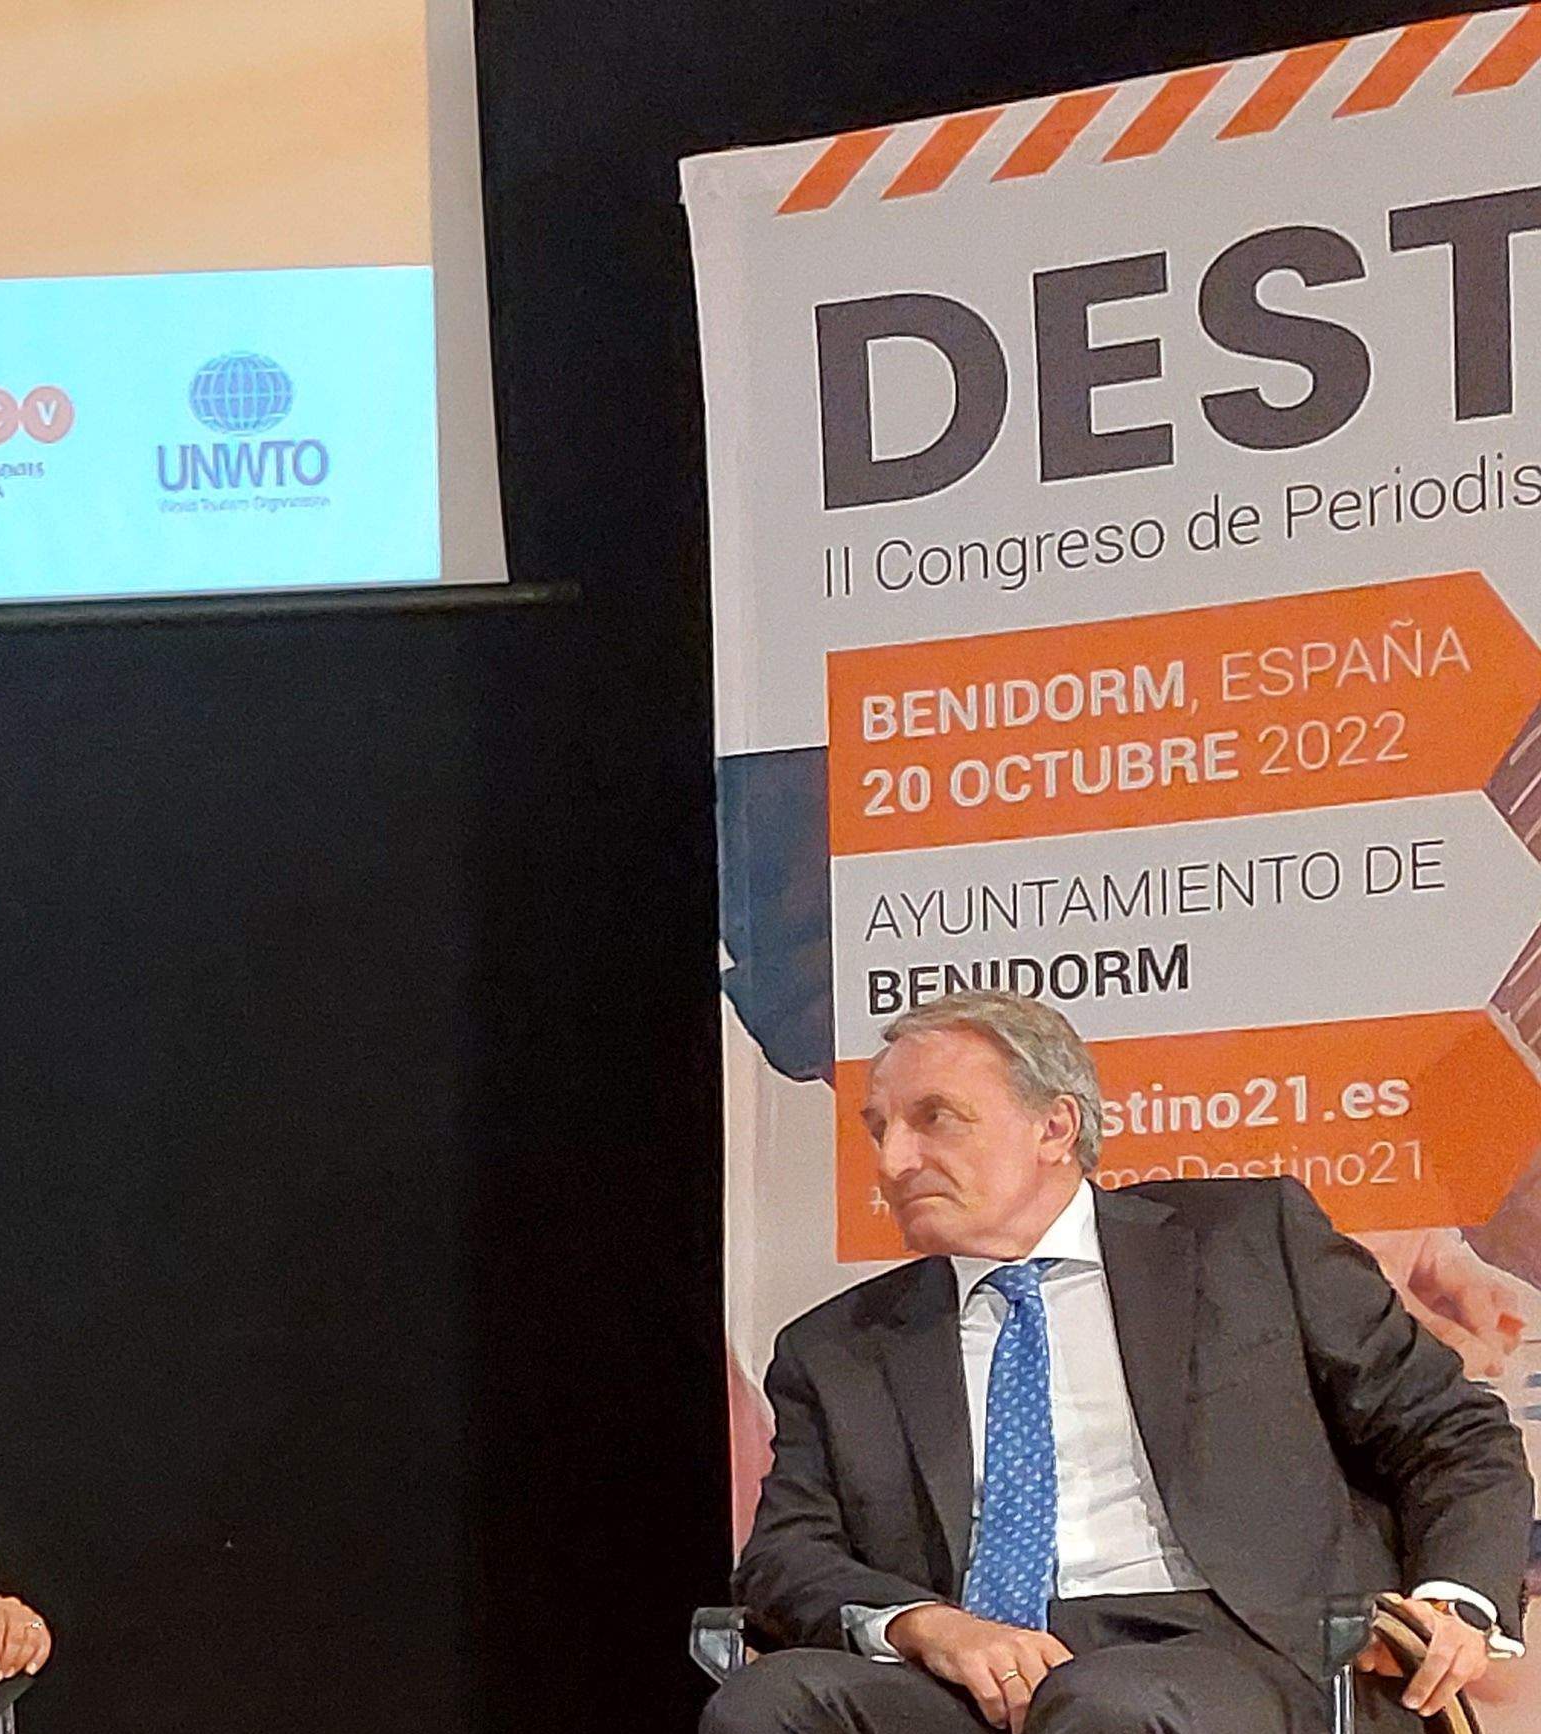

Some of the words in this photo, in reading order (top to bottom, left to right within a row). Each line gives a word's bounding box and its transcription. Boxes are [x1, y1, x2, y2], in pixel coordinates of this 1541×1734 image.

[814, 186, 1541, 511] DEST
[157, 438, 329, 492] UNWTO
[875, 516, 1164, 591] Congreso
[1187, 495, 1261, 551] de
[1286, 452, 1541, 539] Periodis
[862, 659, 1200, 742] BENIDORM,
[1221, 617, 1471, 702] ESPAÑA
[862, 768, 930, 817] 20
[948, 731, 1239, 808] OCTUBRE
[1258, 711, 1410, 777] 2022
[865, 849, 1342, 942] AYUNTAMIENTO
[1364, 839, 1447, 895] DE
[1100, 1074, 1412, 1137] stino21.es
